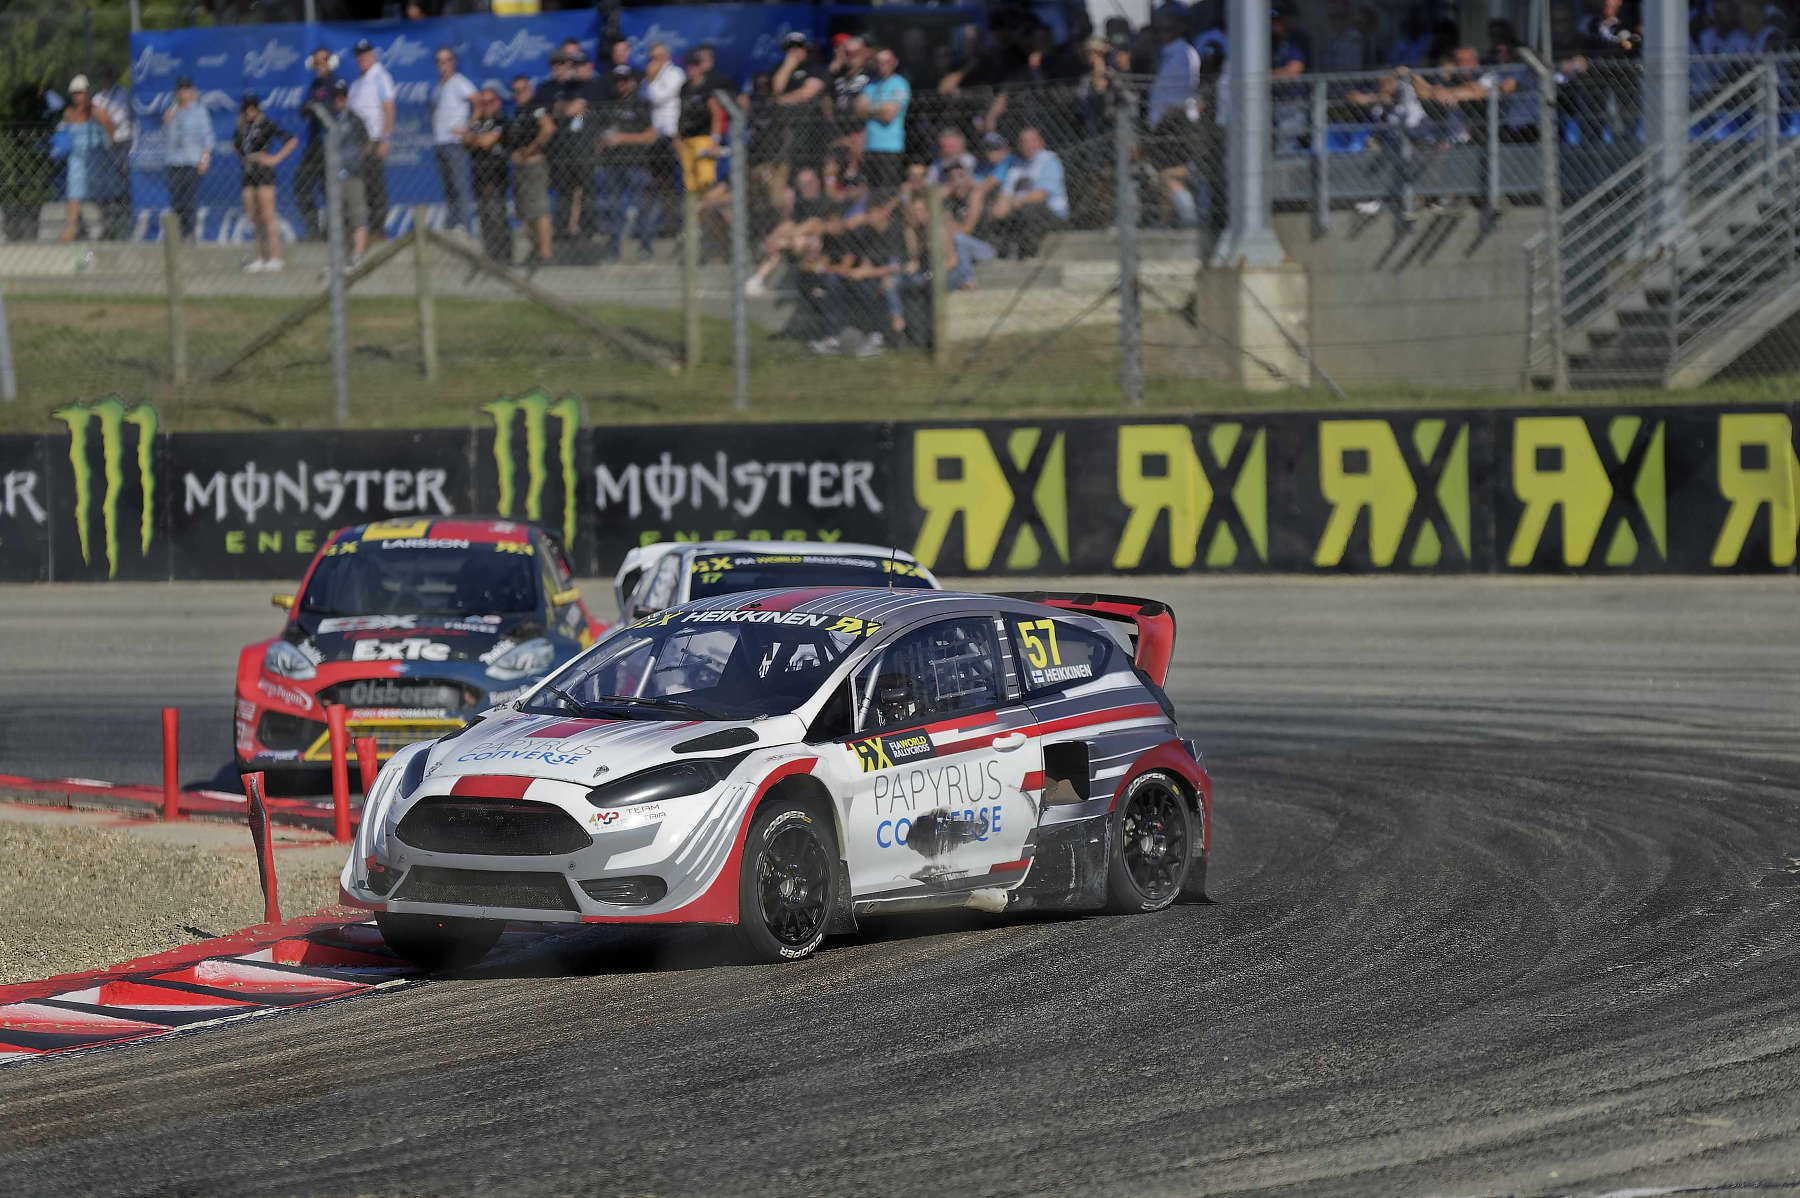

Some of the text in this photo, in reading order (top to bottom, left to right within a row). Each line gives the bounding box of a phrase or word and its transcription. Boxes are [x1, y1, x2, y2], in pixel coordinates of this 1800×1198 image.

[184, 460, 455, 523] MONSTER
[595, 450, 884, 521] MONSTER
[225, 529, 337, 554] ENE
[381, 538, 470, 550] LARSSON
[681, 610, 829, 627] HEIKKINEN
[1017, 619, 1061, 669] 57
[1044, 663, 1093, 682] HEIKKINEN
[457, 750, 584, 765] CONVERSE
[472, 739, 600, 756] PAPYRUS
[893, 743, 931, 759] RALLYCROSS
[874, 760, 1001, 815] PAPYRUS
[763, 810, 806, 841] COOPER
[780, 933, 823, 959] COOPER
